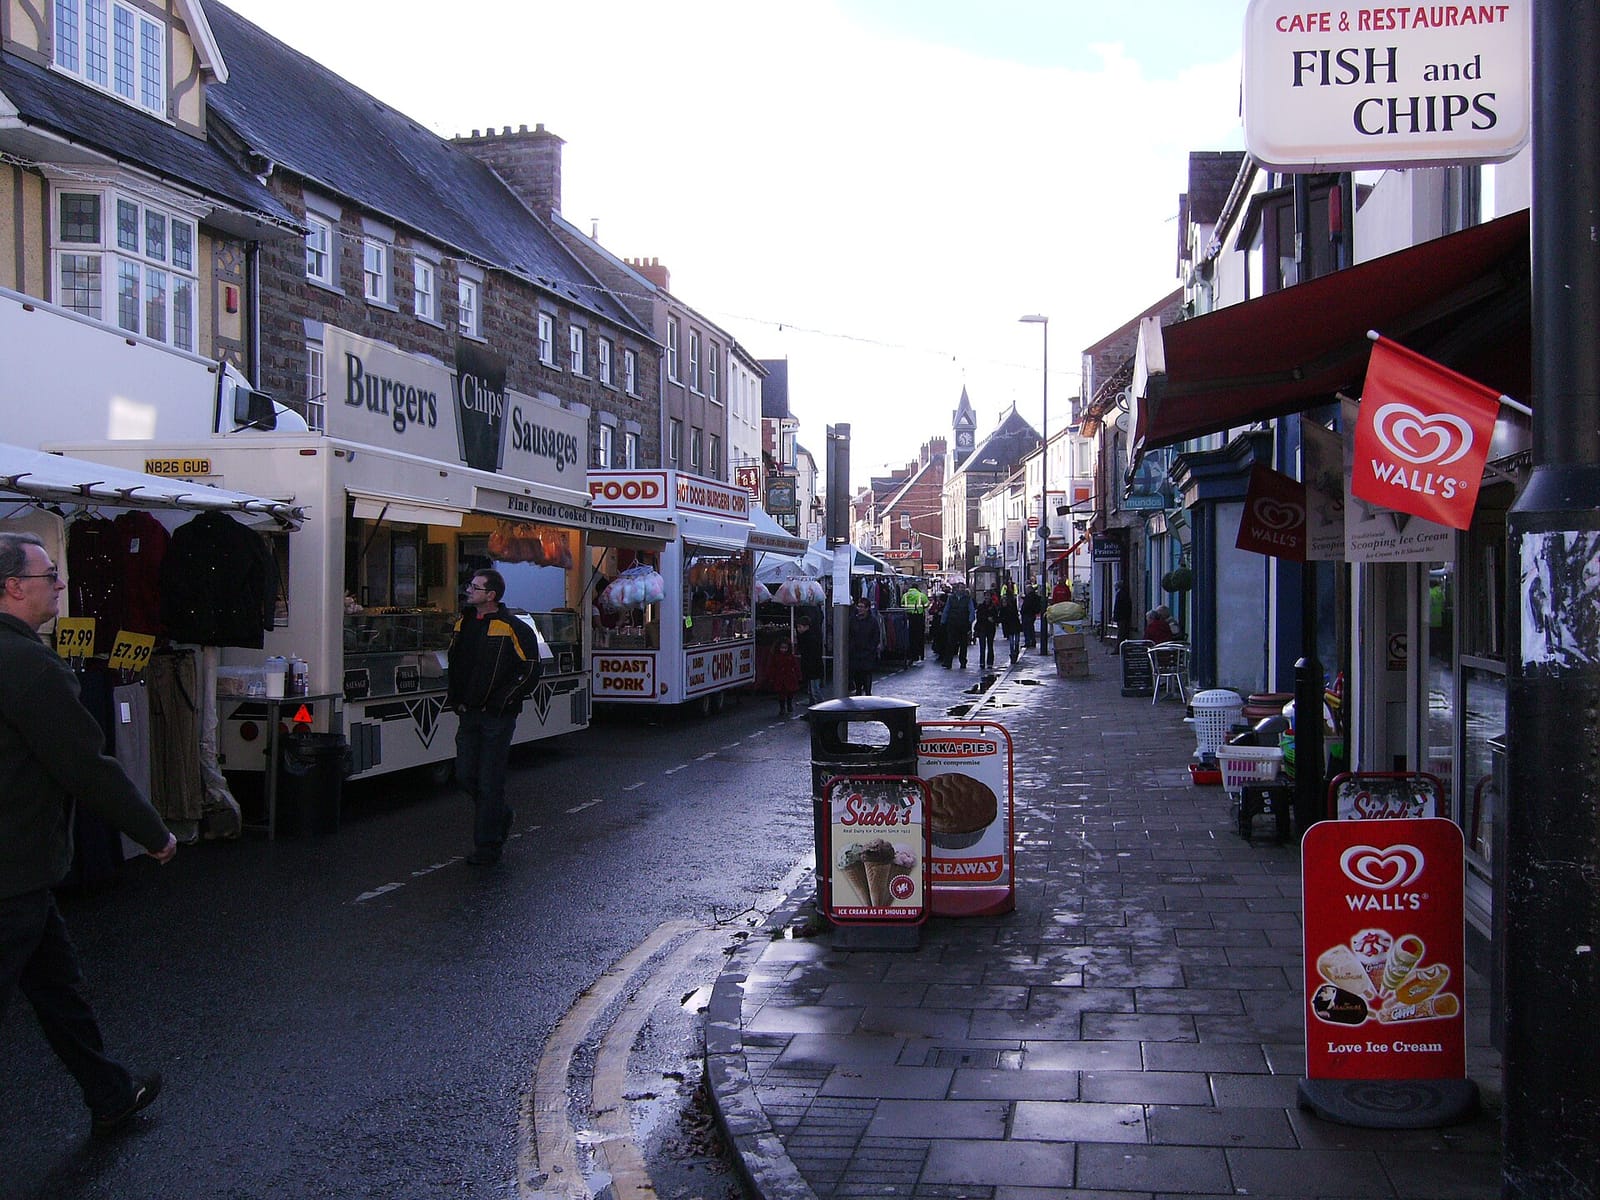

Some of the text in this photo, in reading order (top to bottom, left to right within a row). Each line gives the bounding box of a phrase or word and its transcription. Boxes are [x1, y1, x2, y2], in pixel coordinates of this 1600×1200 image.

[1275, 5, 1509, 33] CAFE & RESTAURANT
[1292, 47, 1481, 87] FISH and
[1353, 93, 1497, 135] CHIPS
[344, 352, 438, 433] Burgers
[461, 373, 504, 425] Chips
[512, 405, 578, 473] Sausages
[145, 460, 209, 473] N826 GUB
[1371, 458, 1456, 500] WALL'S
[589, 481, 660, 500] FOOD
[508, 496, 529, 511] Fine
[531, 501, 557, 517] Foods
[558, 506, 587, 522] Cooked
[590, 511, 610, 526] Fresh
[612, 516, 631, 531] Daily
[631, 519, 643, 531] For
[1252, 528, 1297, 547] WALL'S
[1311, 540, 1345, 551] Scoopin
[1351, 532, 1448, 551] Scooping Ice Cream
[59, 629, 93, 646] £7.99
[113, 642, 150, 661] £7.99
[601, 660, 649, 673] ROAST
[712, 652, 733, 681] CHIPS
[603, 678, 644, 691] PORK
[841, 793, 912, 826] Sidoli's
[1345, 893, 1420, 911] WALL'S
[1327, 1041, 1442, 1053] Love Ice Cream
